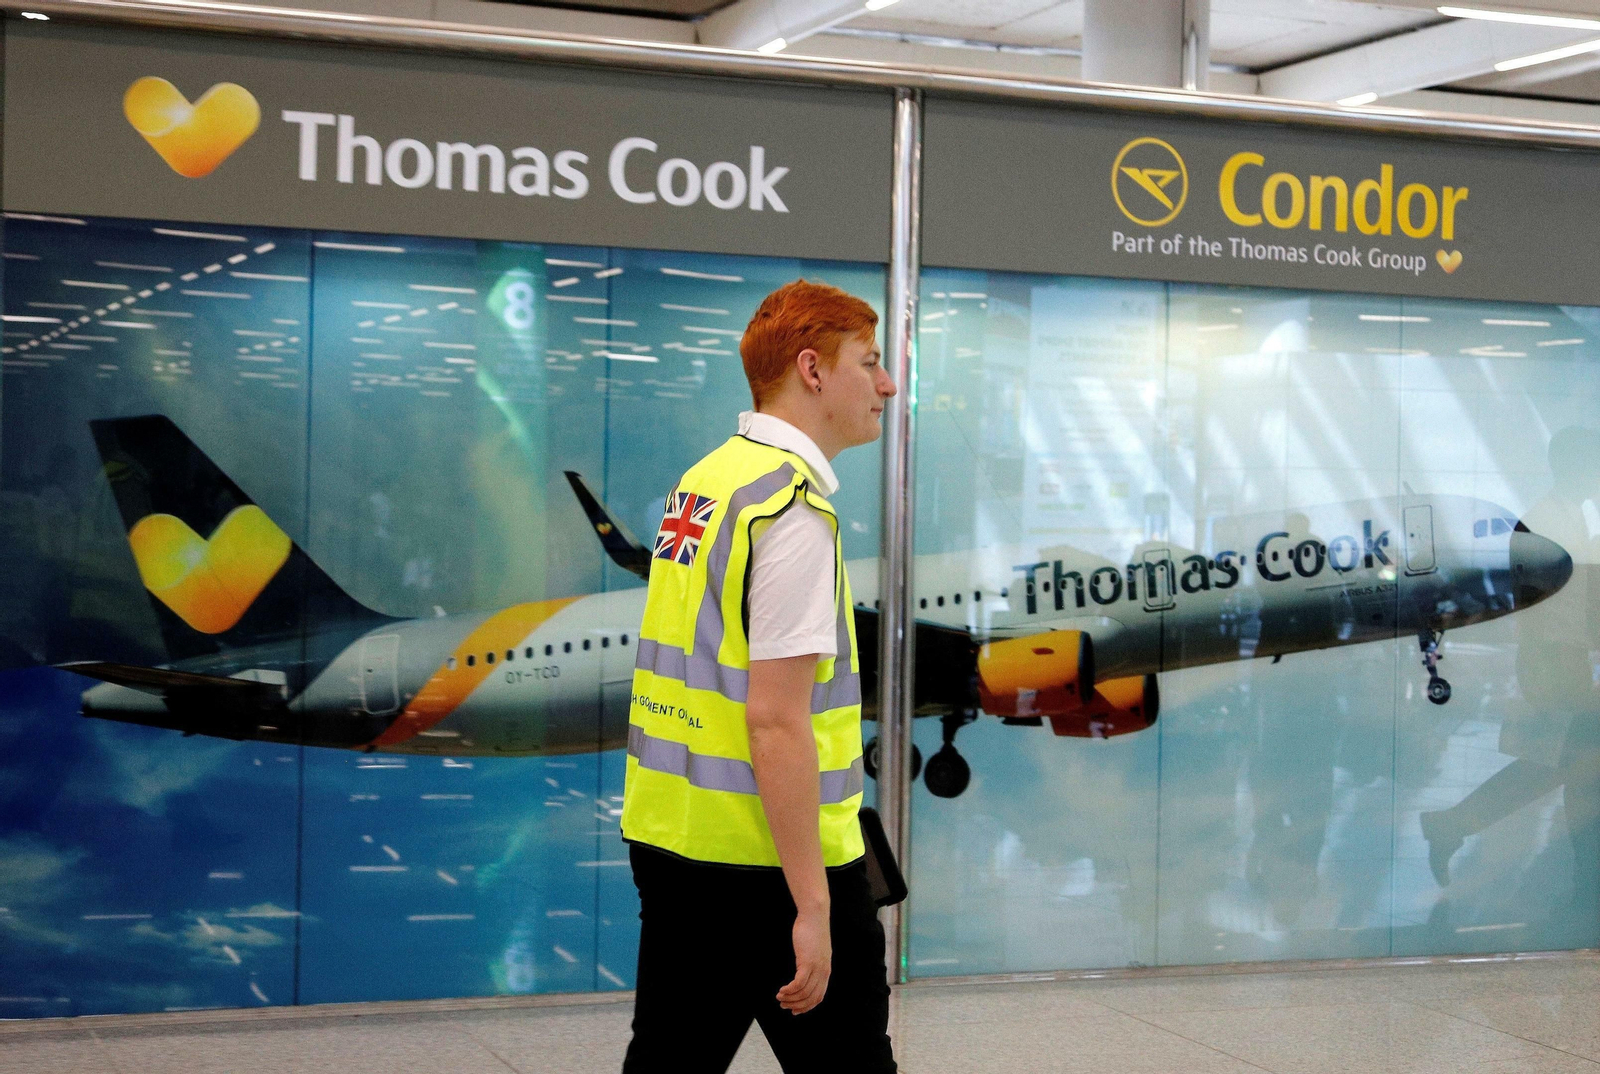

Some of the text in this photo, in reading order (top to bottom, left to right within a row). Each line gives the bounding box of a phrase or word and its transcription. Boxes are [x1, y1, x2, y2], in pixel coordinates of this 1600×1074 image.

[281, 109, 791, 213] Thomas Cook
[1218, 151, 1469, 240] Condor
[1111, 231, 1427, 276] Part of the Thomas Cook Group
[1012, 519, 1394, 615] Thomas Cook
